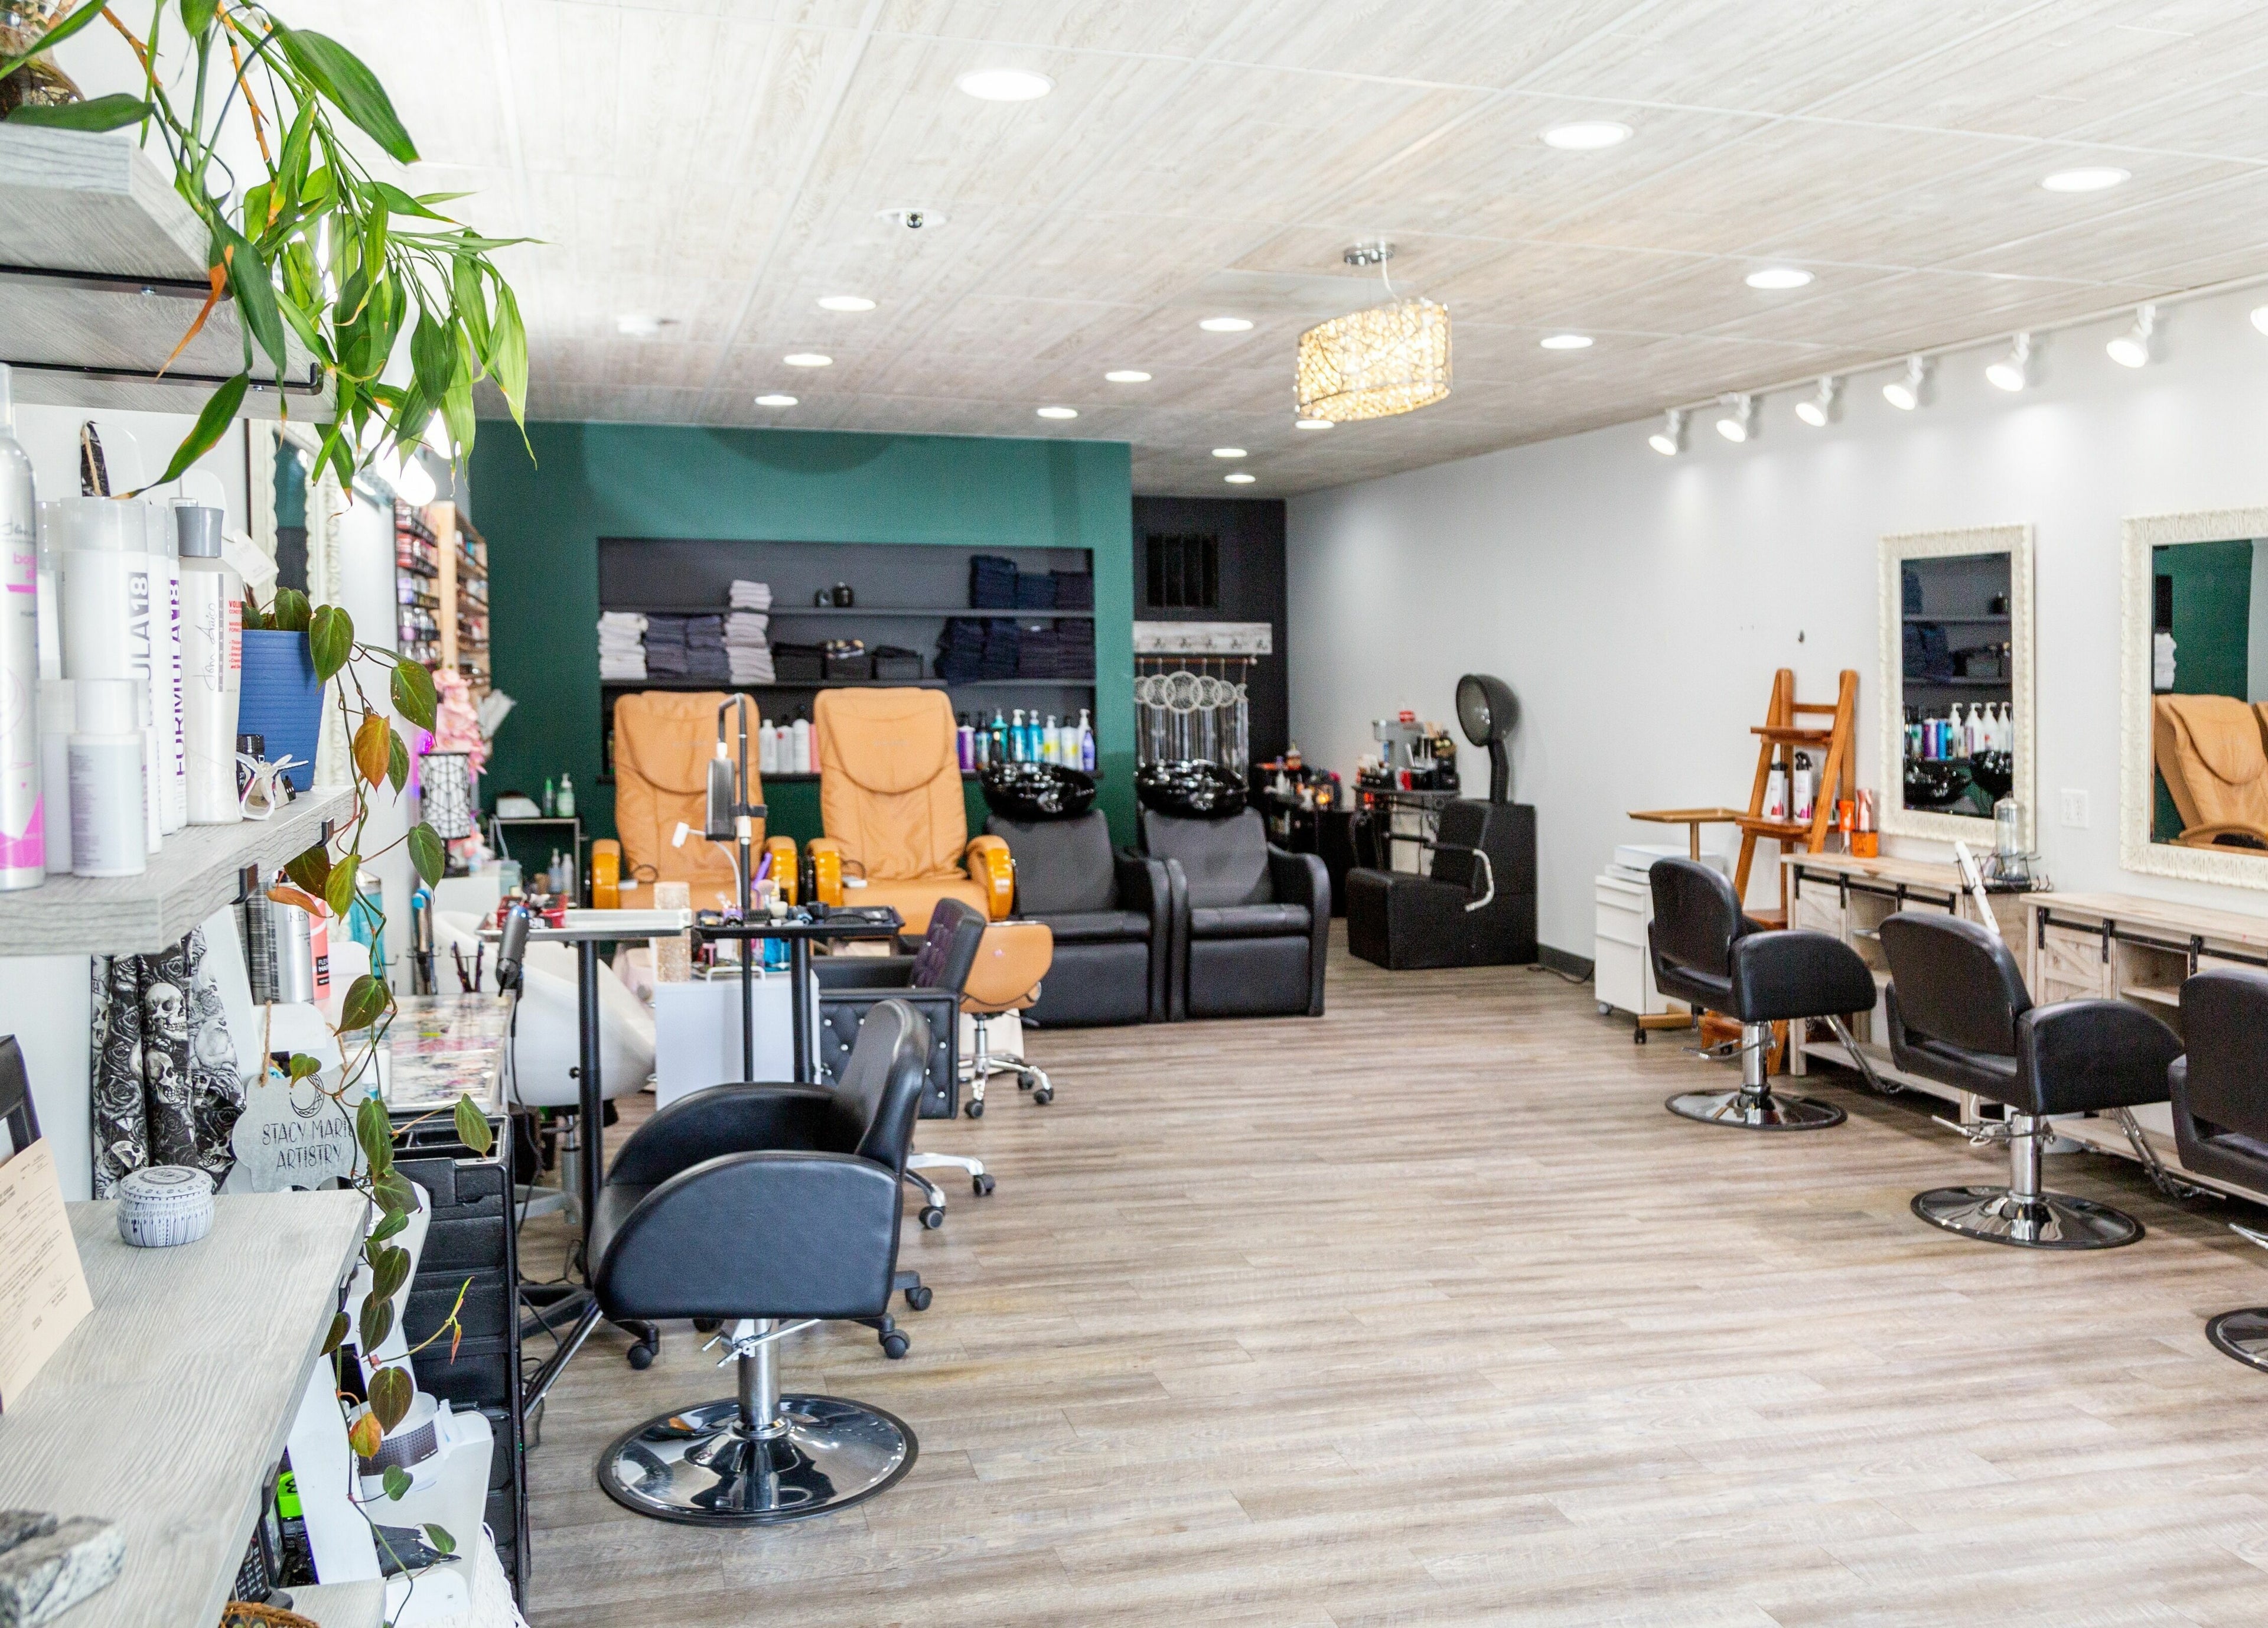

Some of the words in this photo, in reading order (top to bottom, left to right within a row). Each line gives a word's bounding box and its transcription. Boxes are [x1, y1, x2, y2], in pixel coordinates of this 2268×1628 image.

[262, 1122, 307, 1145] STACY
[312, 1116, 354, 1140] MARIE
[276, 1143, 342, 1172] ARTISTRY
